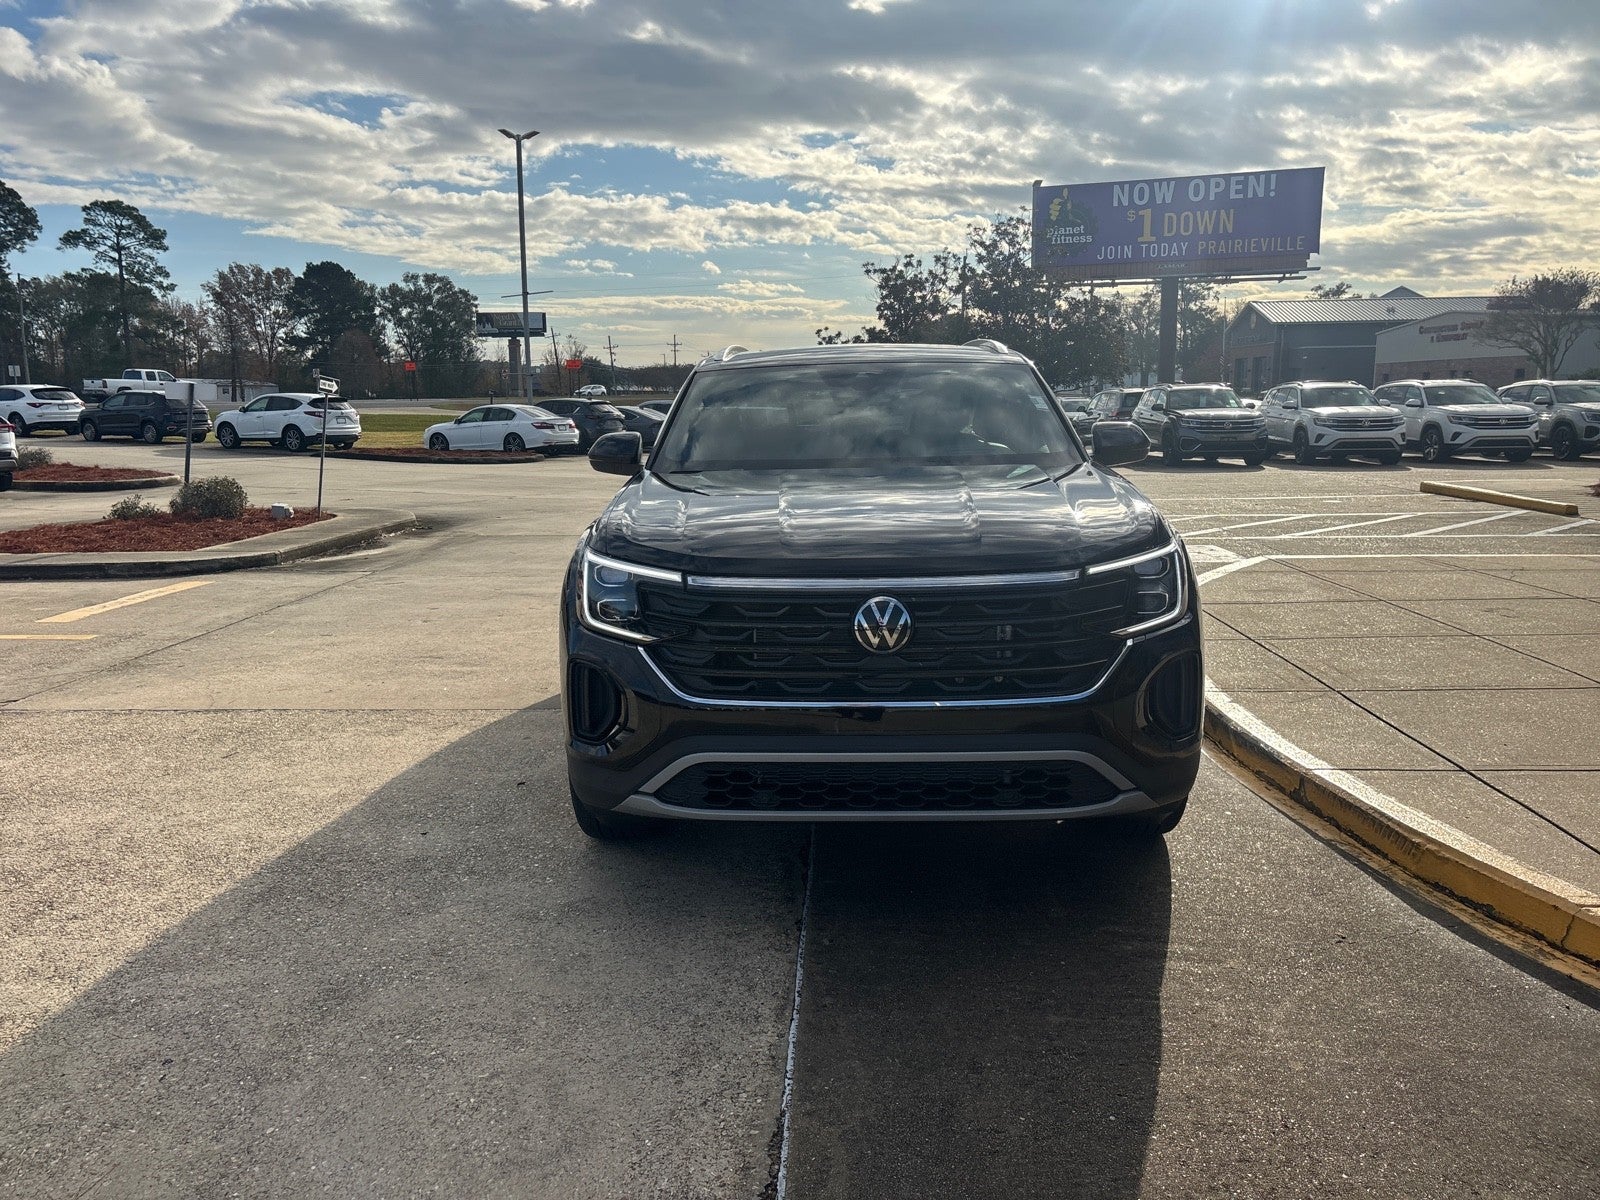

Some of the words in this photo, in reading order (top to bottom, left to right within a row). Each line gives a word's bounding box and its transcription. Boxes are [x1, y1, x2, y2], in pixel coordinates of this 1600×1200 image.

[1112, 181, 1176, 207] NOW
[1188, 174, 1277, 202] OPEN!
[1163, 209, 1234, 237] DOWN
[1096, 245, 1132, 260] JOIN
[1140, 242, 1189, 258] TODAY
[1198, 235, 1306, 255] PRAIRIEVILLE
